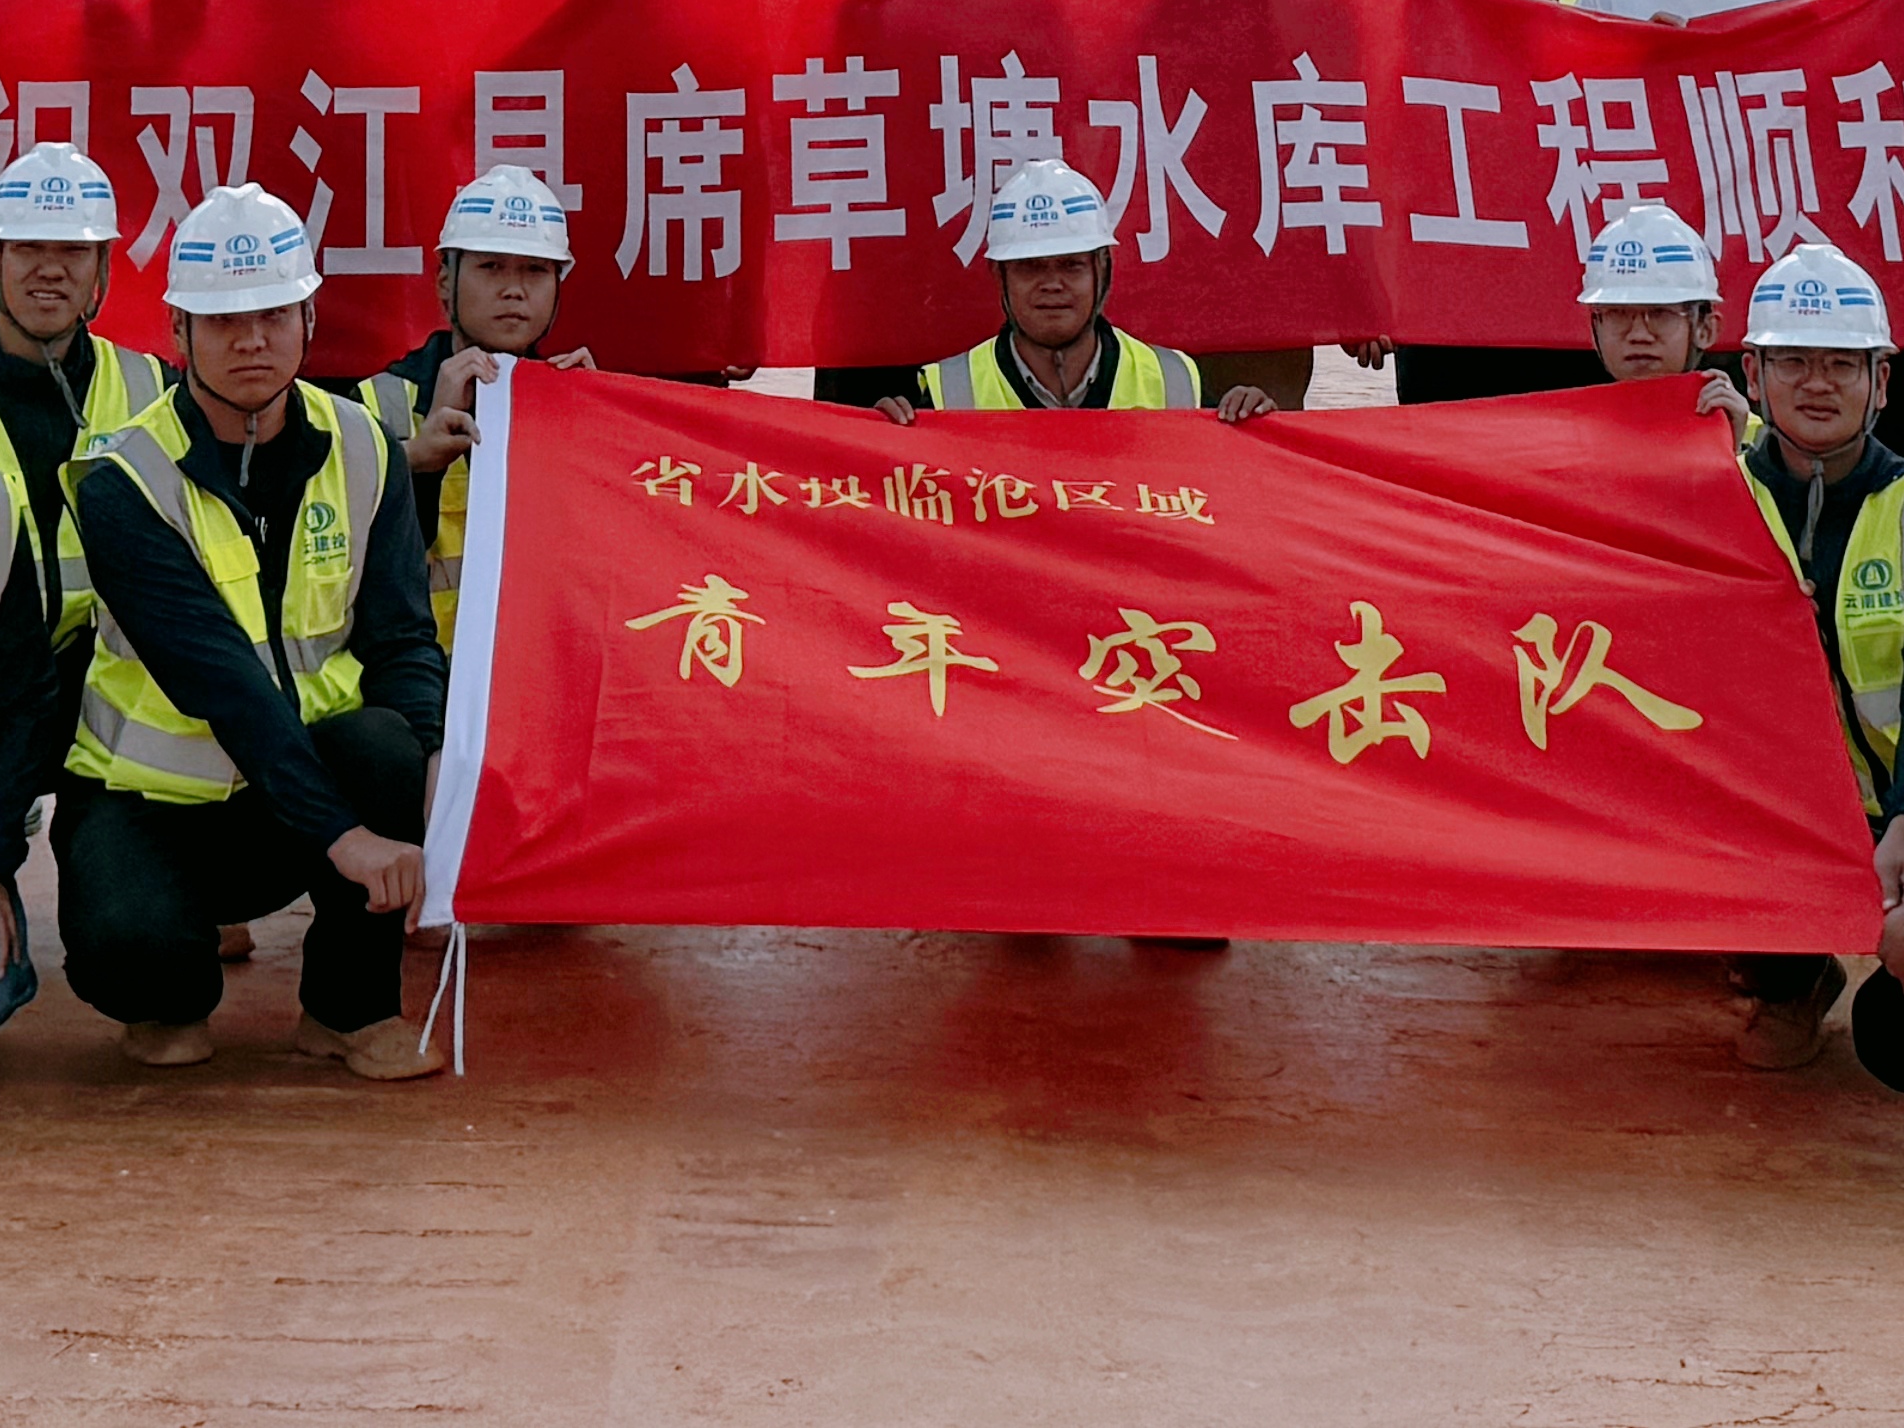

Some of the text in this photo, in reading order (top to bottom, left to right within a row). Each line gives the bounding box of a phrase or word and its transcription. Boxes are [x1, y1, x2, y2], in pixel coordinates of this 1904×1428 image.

[626, 575, 1702, 763] 青年突击队
